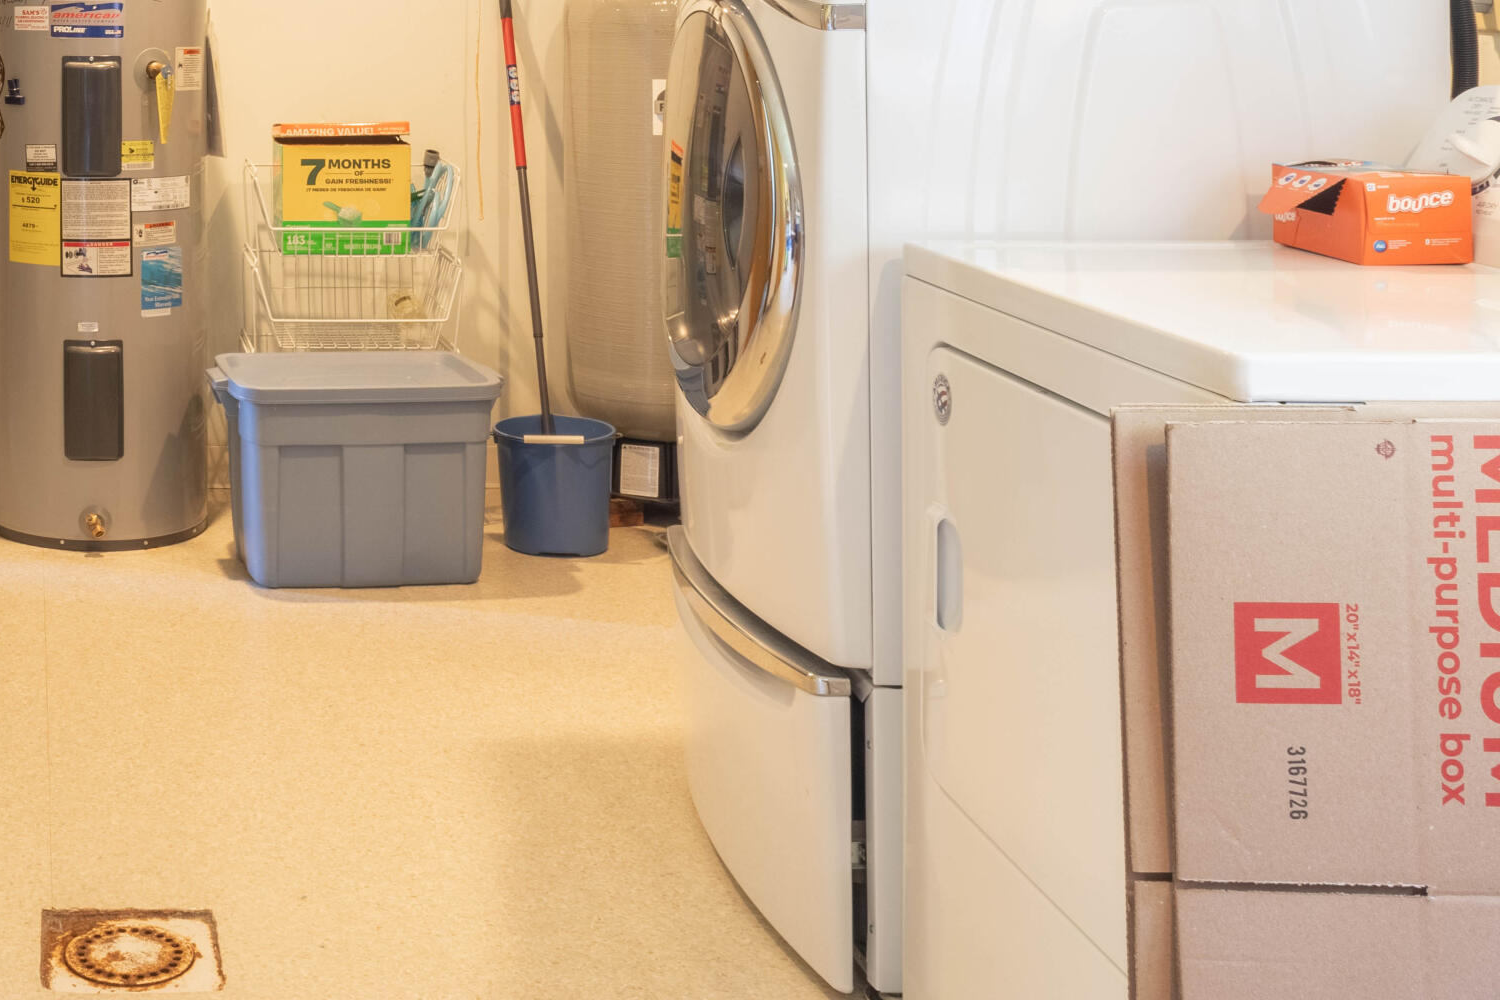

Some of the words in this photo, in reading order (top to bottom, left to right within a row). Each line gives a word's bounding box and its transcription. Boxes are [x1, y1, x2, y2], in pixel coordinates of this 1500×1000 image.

[285, 127, 336, 137] AMAZING
[339, 126, 375, 137] VALUE!
[11, 175, 59, 187] ENERGYGUIDE
[300, 158, 327, 186] 7
[328, 158, 392, 170] MONTHS
[1387, 189, 1455, 214] bounce
[1427, 434, 1466, 720] multi-purpose
[1254, 617, 1321, 689] M
[1286, 746, 1309, 821] 3167726
[1439, 733, 1471, 806] box
